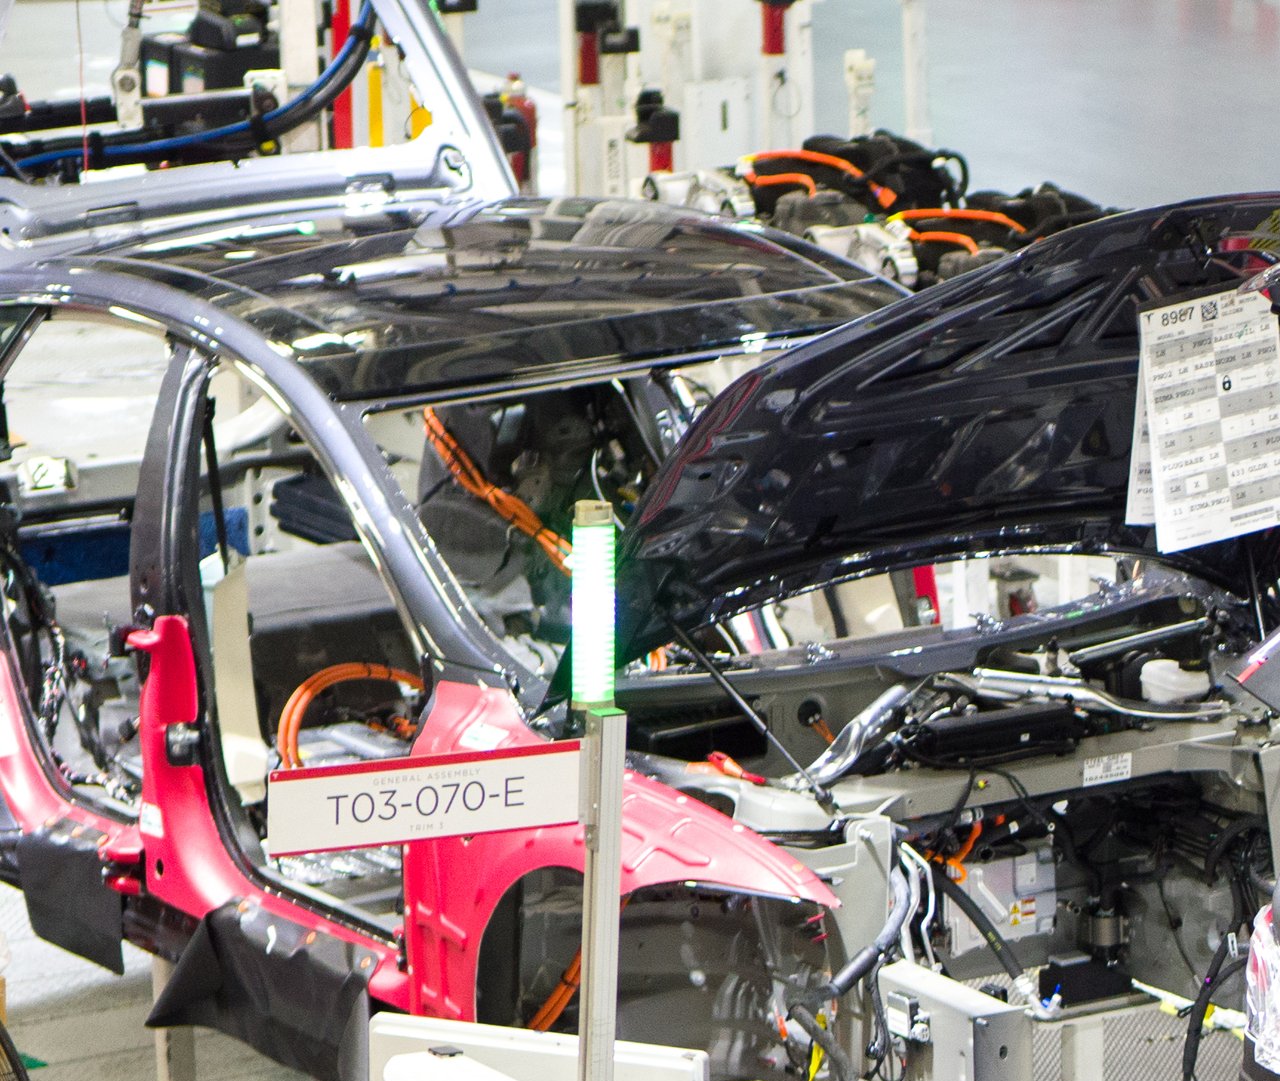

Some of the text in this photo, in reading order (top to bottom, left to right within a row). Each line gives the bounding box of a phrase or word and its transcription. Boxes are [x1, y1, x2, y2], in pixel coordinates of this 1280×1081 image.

[372, 767, 482, 786] GENERAL ASSEMBLY
[326, 775, 526, 826] T03-070-E
